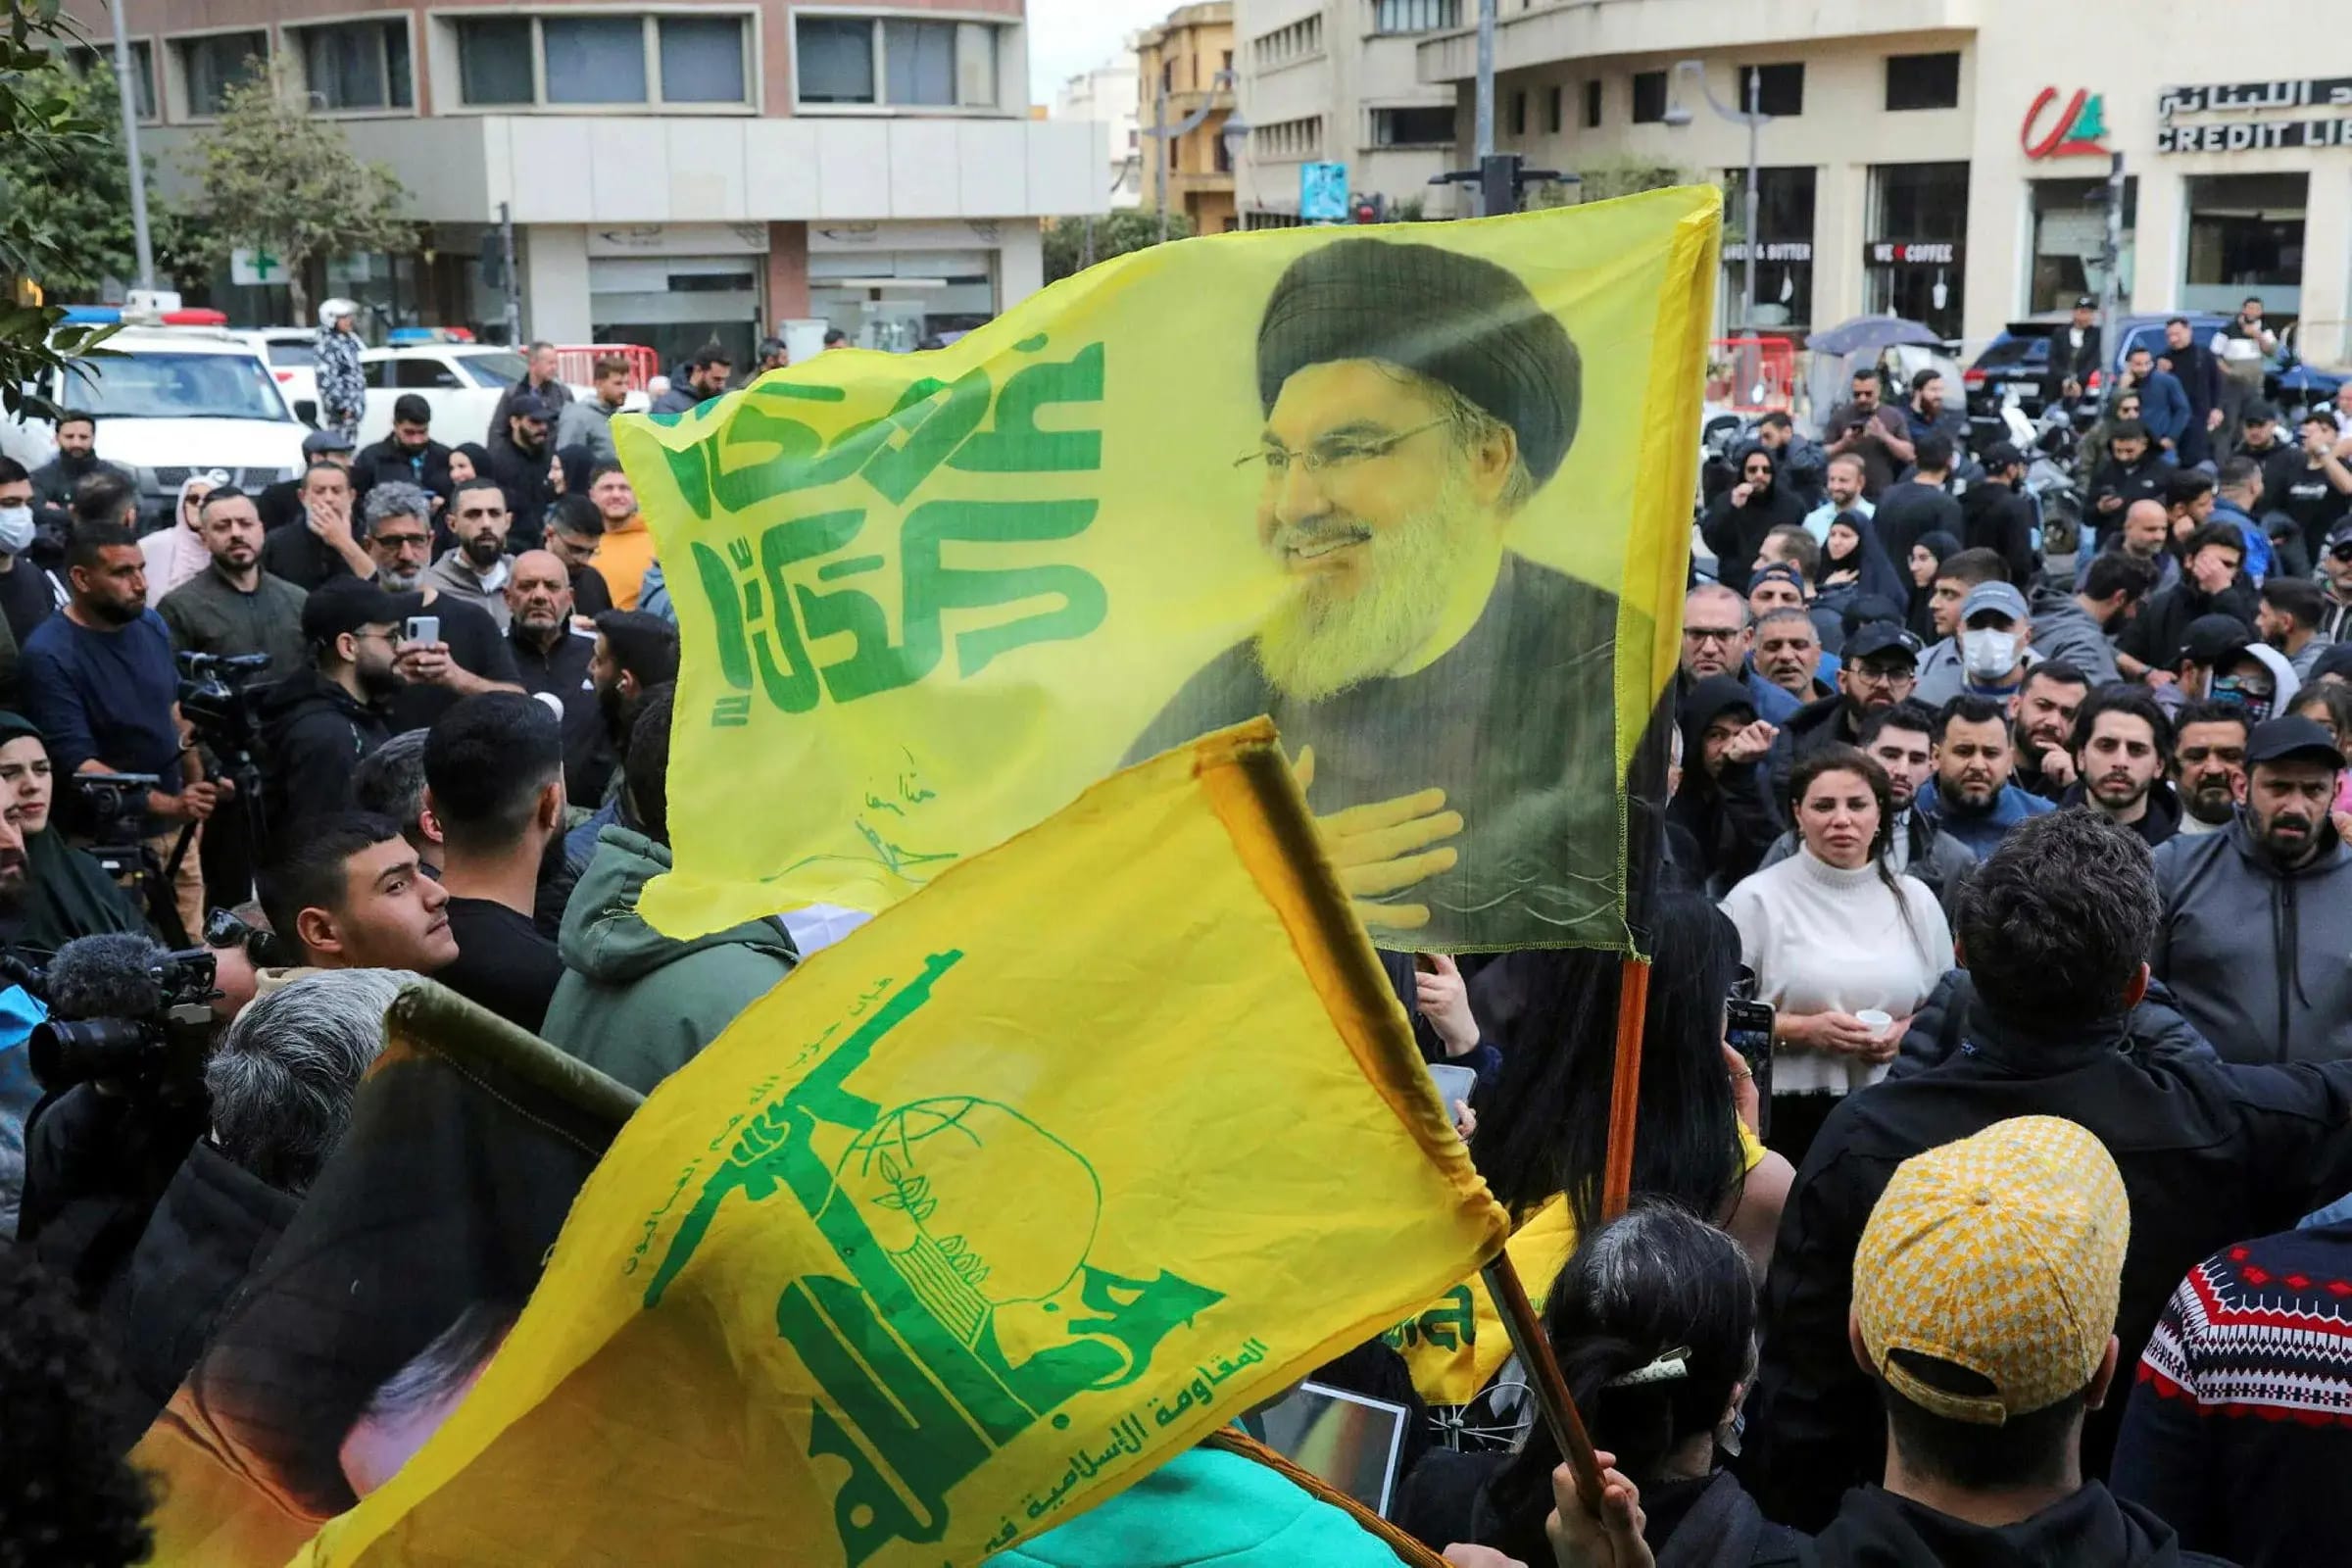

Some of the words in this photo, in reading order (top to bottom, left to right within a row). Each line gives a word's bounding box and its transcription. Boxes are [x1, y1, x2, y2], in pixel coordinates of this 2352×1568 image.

[2157, 80, 2313, 125] اللبناني
[2157, 122, 2291, 153] CREDIT
[1874, 243, 1893, 263] WE
[1904, 243, 1953, 263] COFFEE
[709, 1113, 745, 1152] هم
[1148, 1338, 1269, 1428] المقاومة
